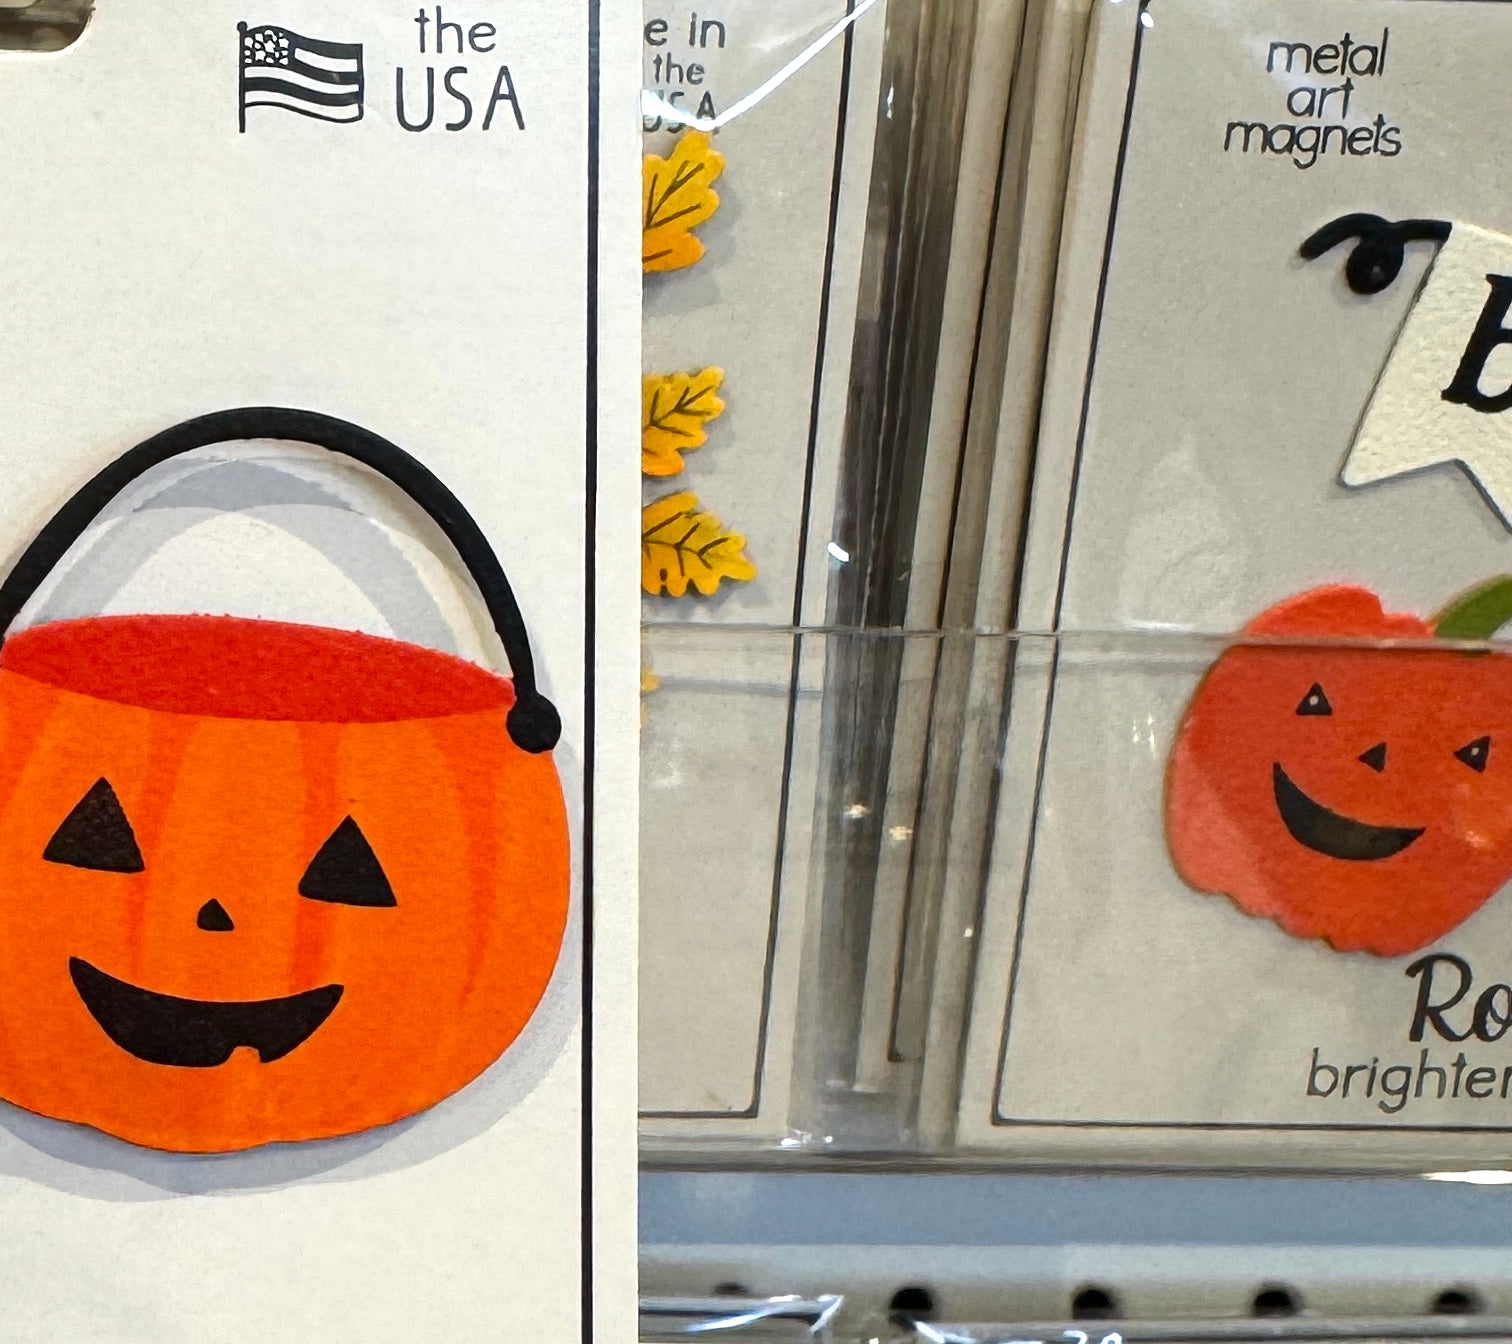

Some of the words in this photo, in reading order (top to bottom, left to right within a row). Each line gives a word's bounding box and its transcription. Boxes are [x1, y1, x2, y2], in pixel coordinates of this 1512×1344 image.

[414, 6, 497, 55] the
[688, 12, 726, 49] in
[1266, 27, 1389, 77] metal
[653, 52, 706, 85] the
[396, 66, 526, 132] USA
[1287, 77, 1355, 120] art
[1224, 113, 1403, 170] magnets
